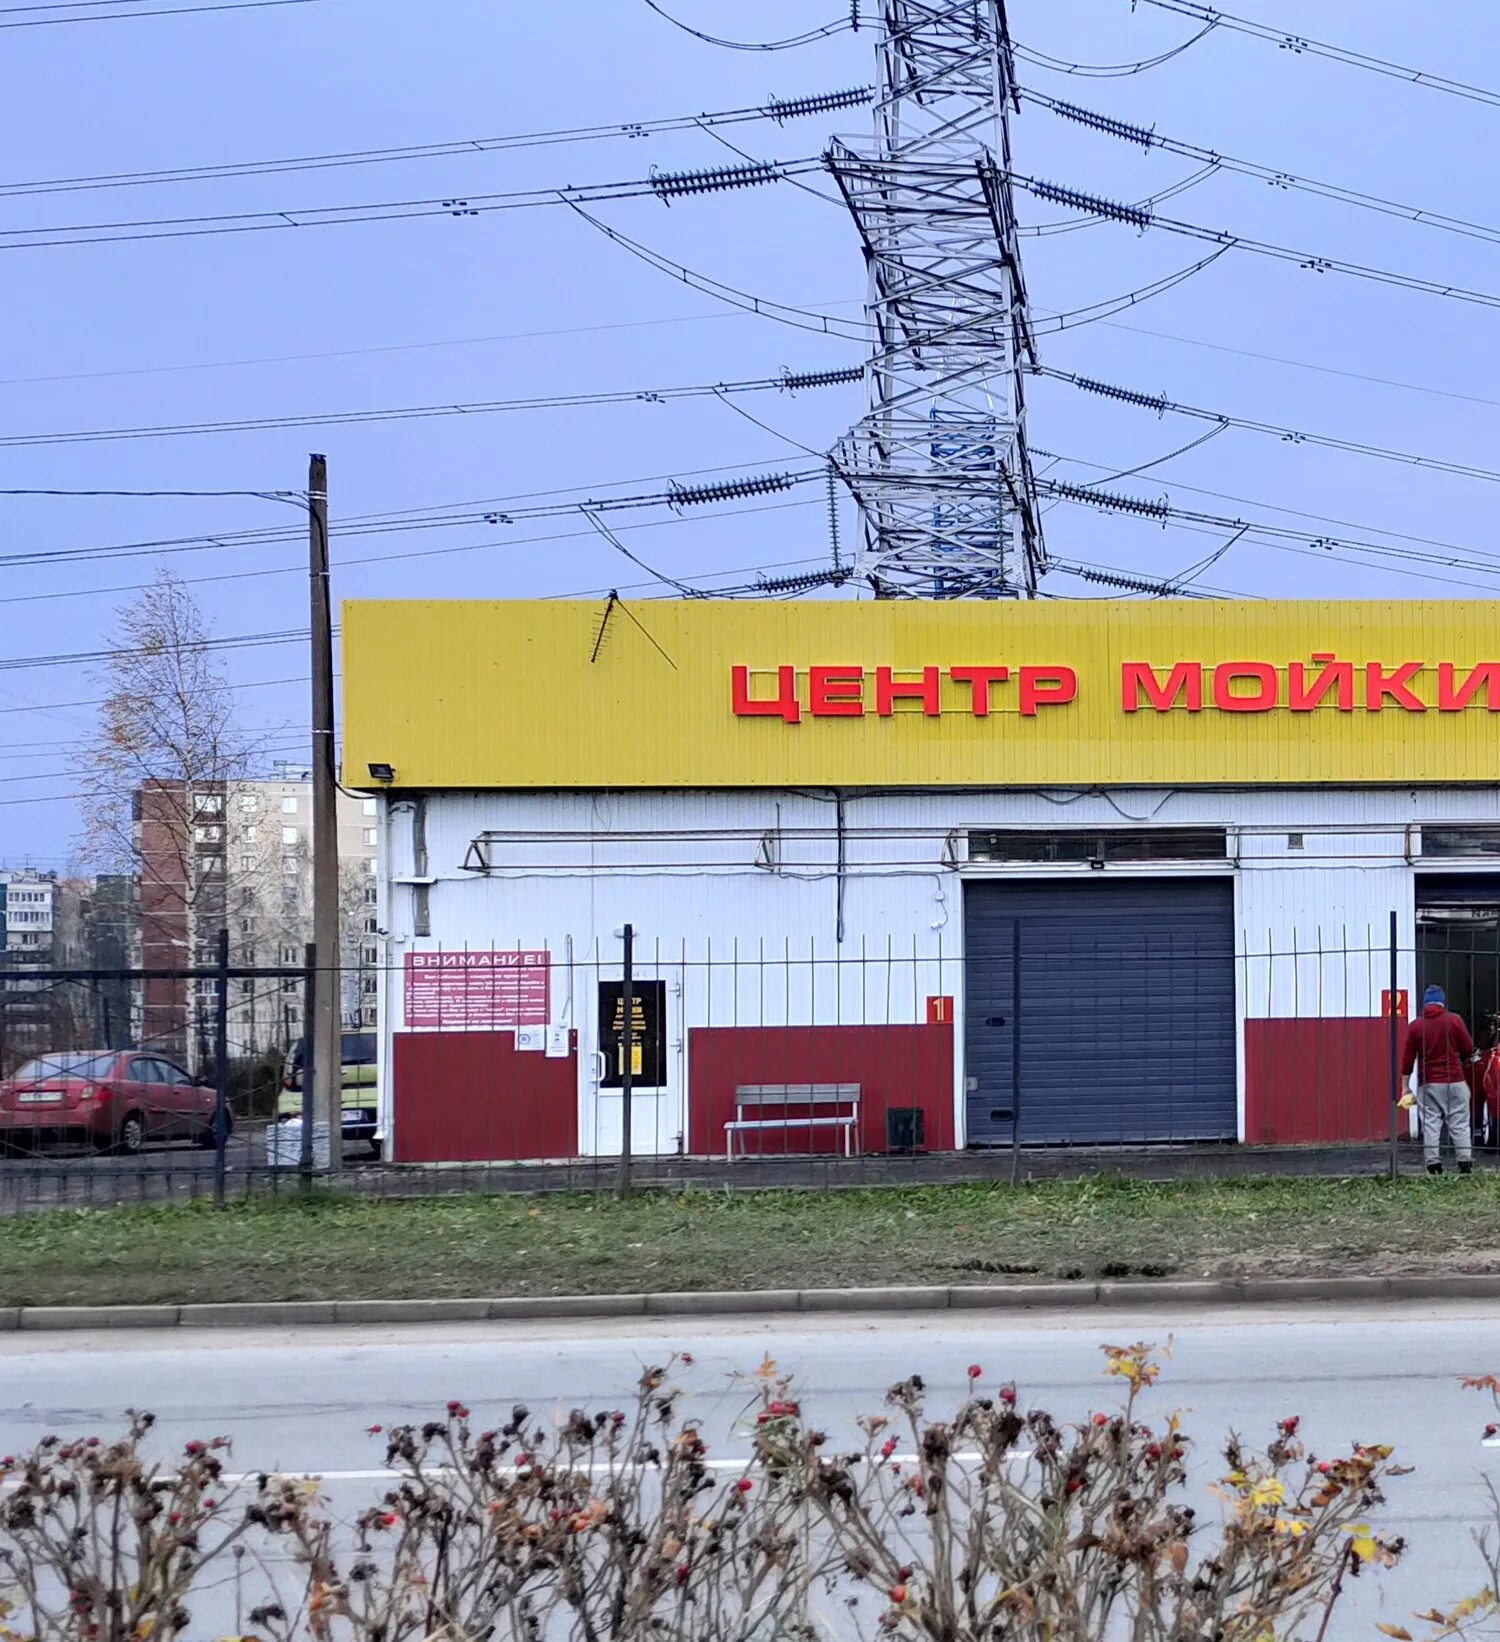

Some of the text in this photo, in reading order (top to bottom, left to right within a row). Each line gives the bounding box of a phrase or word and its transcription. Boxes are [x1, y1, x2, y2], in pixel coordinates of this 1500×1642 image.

[731, 665, 1077, 722] ЦЕНТР
[412, 954, 542, 967] ВНИМАНИЕ!
[617, 997, 642, 1006] ЦТР
[932, 997, 944, 1021] 1
